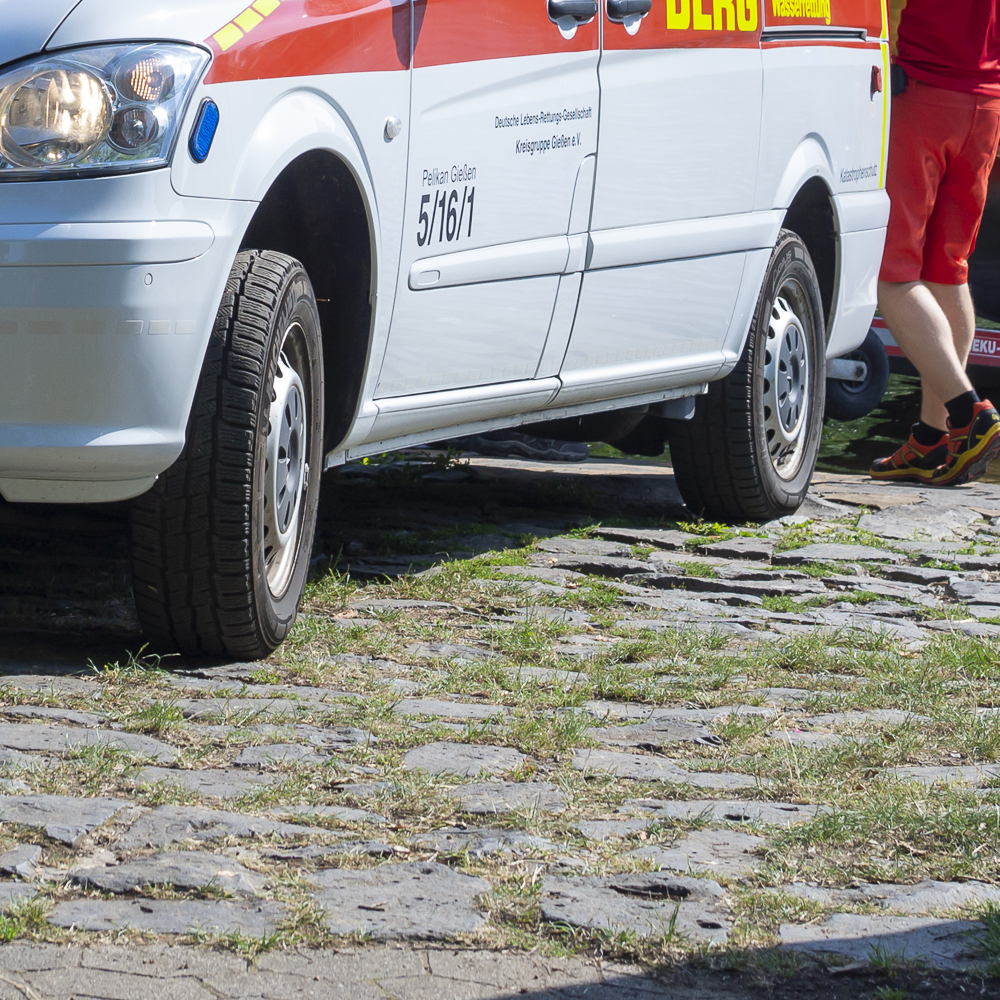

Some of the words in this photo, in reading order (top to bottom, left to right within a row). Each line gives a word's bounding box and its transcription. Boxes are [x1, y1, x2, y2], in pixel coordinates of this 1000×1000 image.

[494, 115, 520, 129] Deutsche
[520, 106, 592, 126] Lebens-Rettungs-Gesellschaft
[515, 138, 551, 156] Kreisgruppe
[551, 134, 571, 150] Gießen
[571, 132, 582, 147] e.V.
[422, 169, 449, 188] Pelikan
[450, 163, 477, 184] Gießen
[416, 185, 476, 248] 5/16/1
